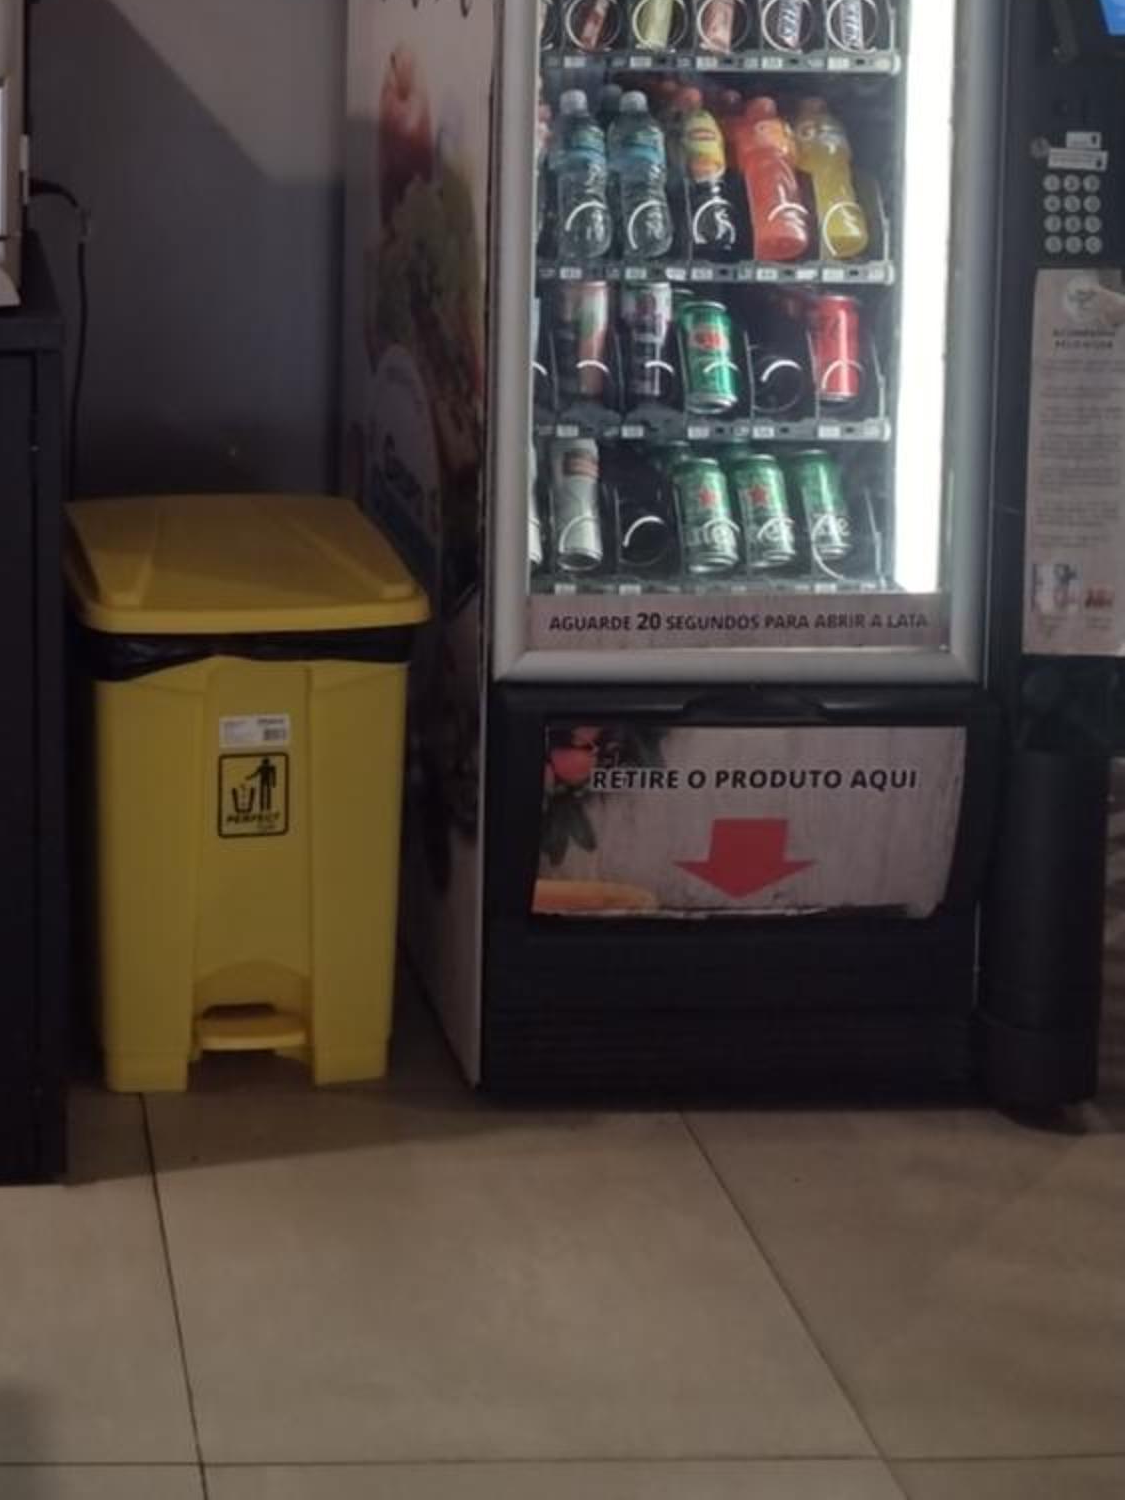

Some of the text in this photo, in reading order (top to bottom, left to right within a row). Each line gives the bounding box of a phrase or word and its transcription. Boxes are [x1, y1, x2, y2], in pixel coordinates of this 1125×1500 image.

[548, 611, 928, 631] AGUARDE 20 SEGUNDOS PARA ABRIR A LATA
[592, 768, 918, 793] RETIRE O PRODUTO AQUI
